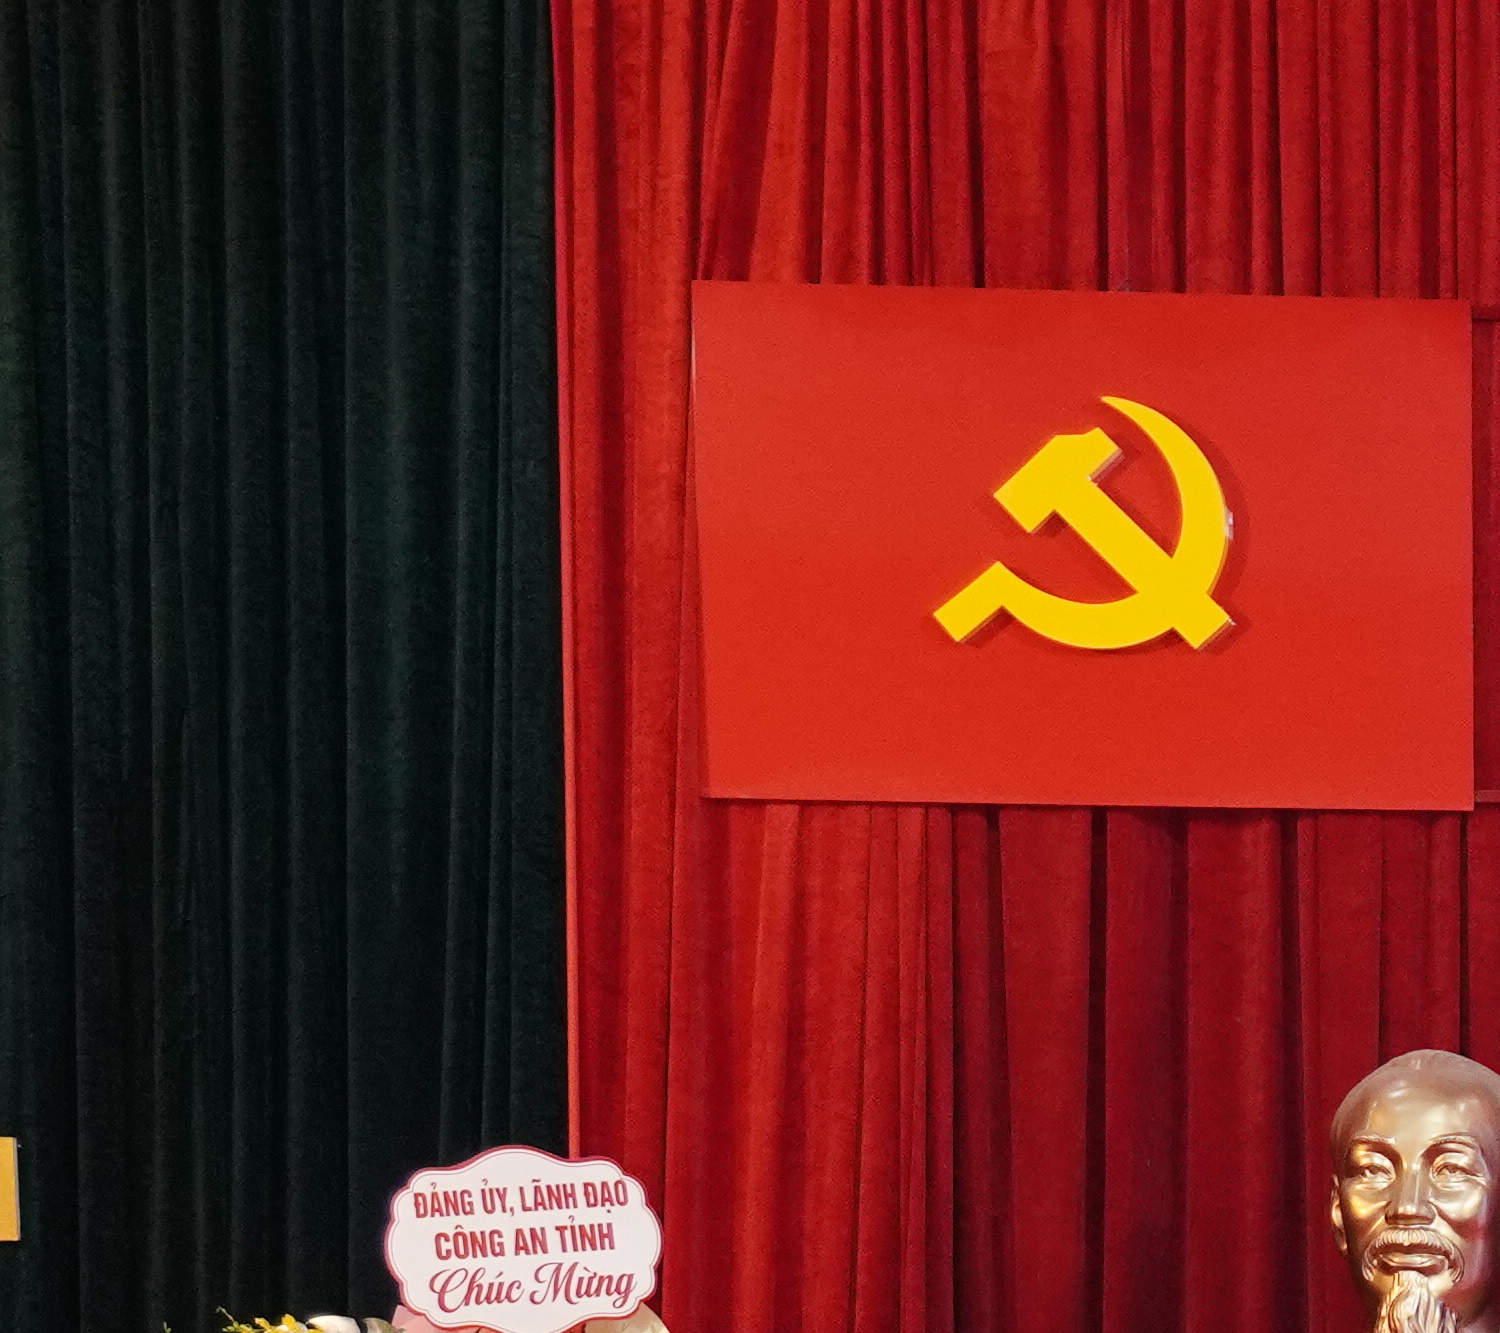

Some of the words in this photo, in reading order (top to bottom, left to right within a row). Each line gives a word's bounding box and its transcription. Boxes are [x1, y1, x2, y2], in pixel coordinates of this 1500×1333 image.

[414, 1182, 475, 1219] ĐẢNG
[482, 1178, 515, 1217] ỦY,
[519, 1179, 579, 1213] LÃNH
[583, 1179, 629, 1214] ĐẠO
[434, 1225, 506, 1261] CÔNG
[514, 1227, 549, 1256] AN
[555, 1215, 616, 1253] TỈNH
[429, 1267, 525, 1313] Chúc
[529, 1261, 639, 1309] Mừng
